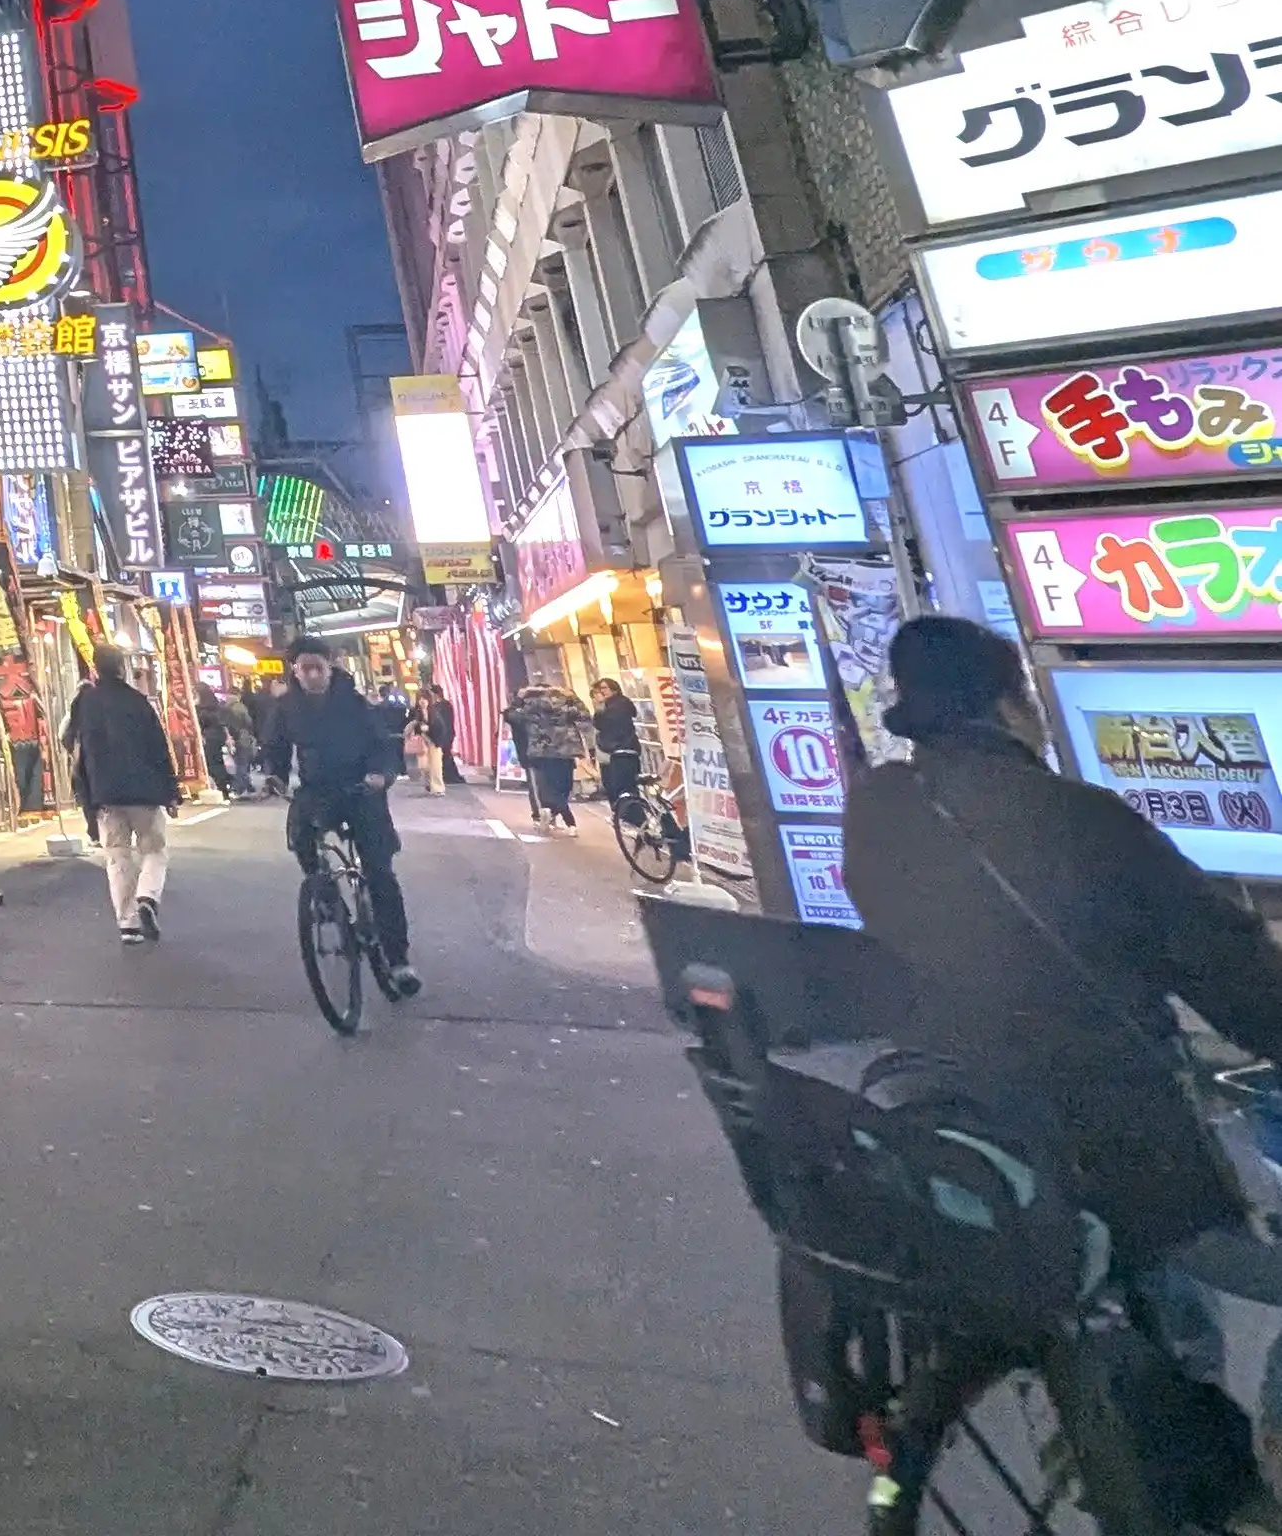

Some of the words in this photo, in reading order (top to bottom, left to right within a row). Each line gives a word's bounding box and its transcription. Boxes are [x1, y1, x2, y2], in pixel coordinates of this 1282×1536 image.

[1020, 225, 1186, 275] サウナ
[1044, 367, 1270, 462] 手もみ
[708, 507, 857, 528] グランシャトー
[724, 590, 794, 614] サウナ
[762, 706, 792, 725] 4F
[1148, 765, 1214, 780] MACHINE
[1218, 768, 1263, 783] DEBUT
